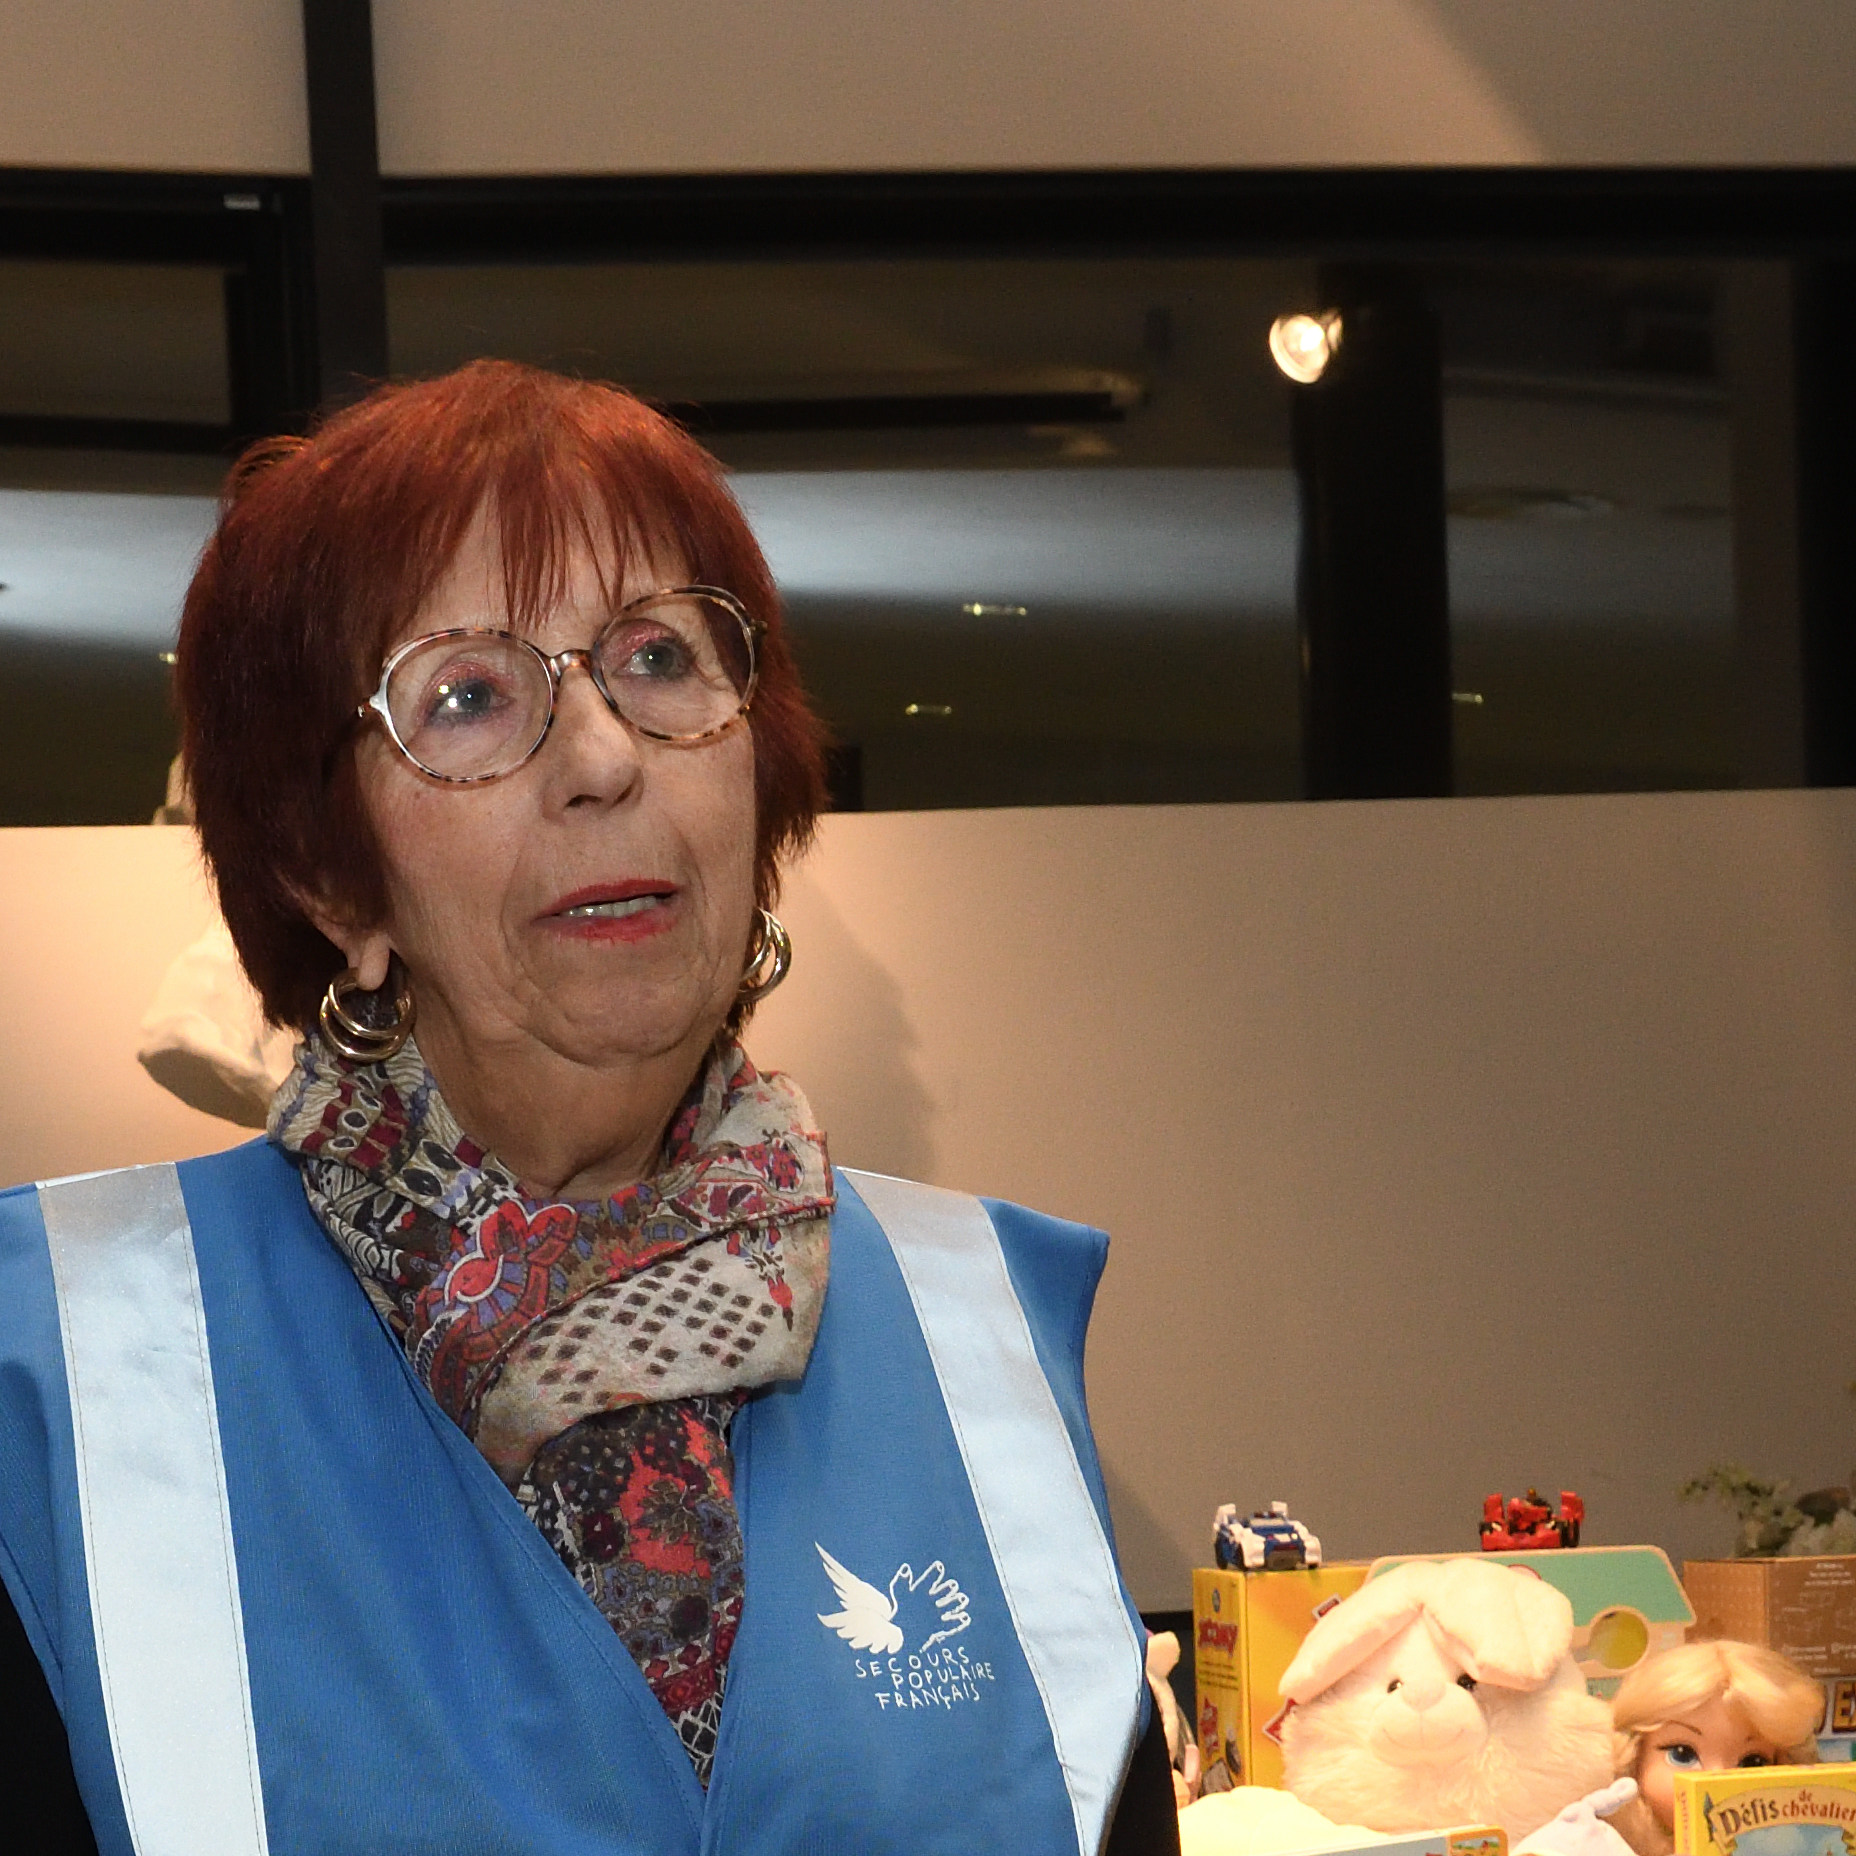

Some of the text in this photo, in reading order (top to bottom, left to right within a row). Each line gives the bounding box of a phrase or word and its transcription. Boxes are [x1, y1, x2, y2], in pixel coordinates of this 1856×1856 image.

[855, 1647, 969, 1678] SECOURS
[891, 1662, 995, 1690] POPULAIRE
[875, 1682, 980, 1710] FRANÇAIS
